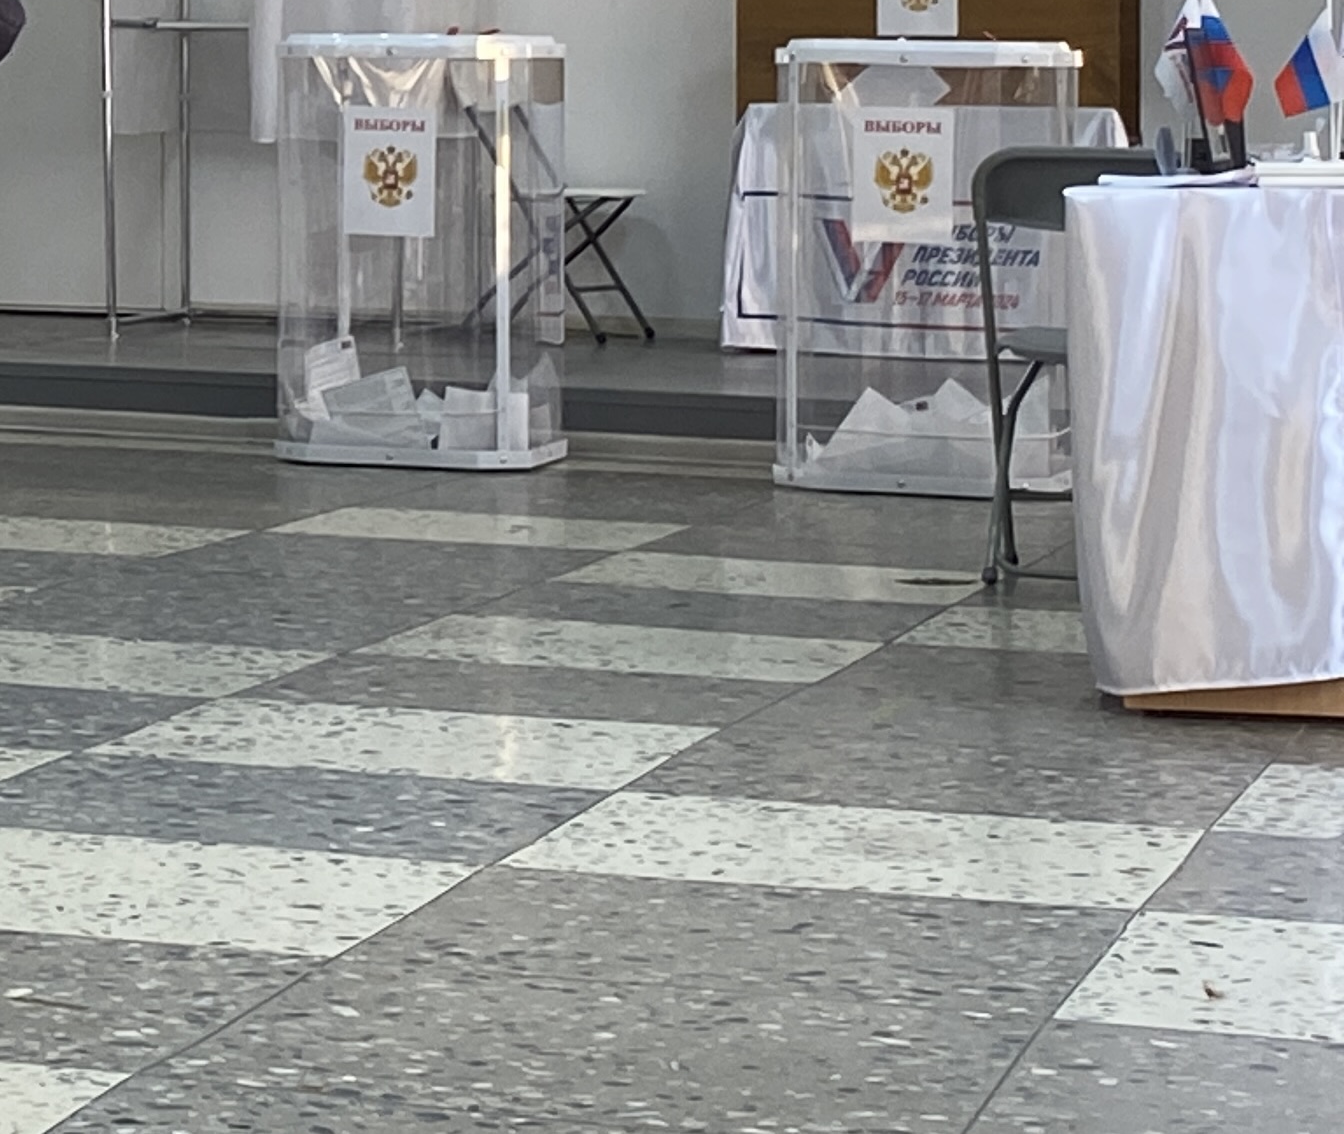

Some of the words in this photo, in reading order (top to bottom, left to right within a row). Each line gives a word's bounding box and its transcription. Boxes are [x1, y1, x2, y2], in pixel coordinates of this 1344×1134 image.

[355, 118, 425, 132] ВЫБОРЫ
[864, 120, 942, 134] ВЫБОРЫ
[912, 245, 1041, 267] ПРЕЗИЕНТА
